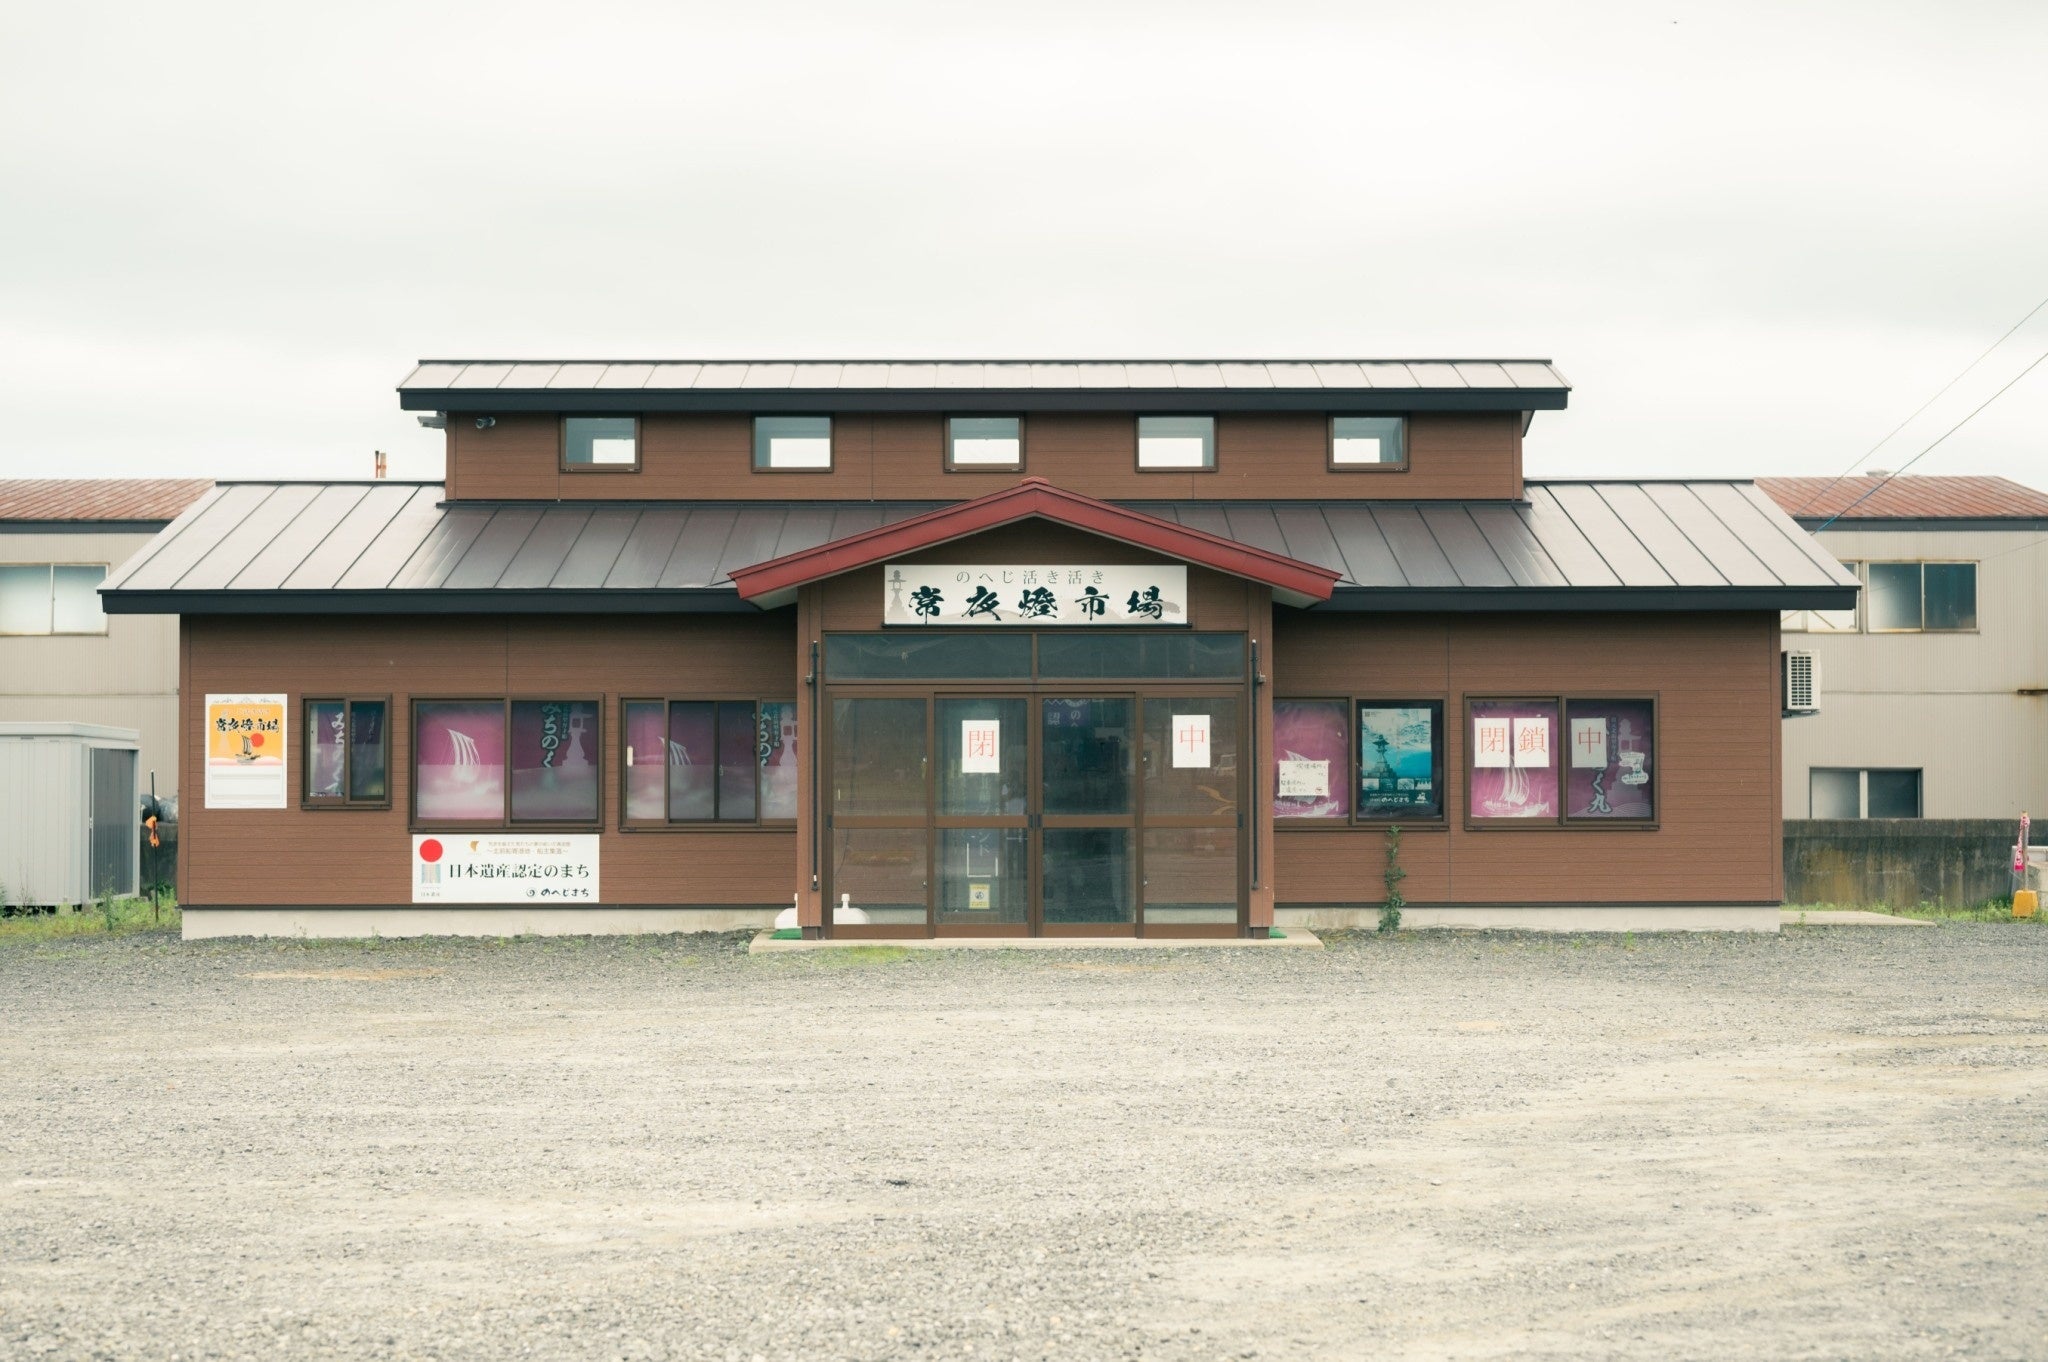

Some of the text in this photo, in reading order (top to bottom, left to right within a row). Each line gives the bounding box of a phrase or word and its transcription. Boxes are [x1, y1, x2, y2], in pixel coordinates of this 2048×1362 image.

[956, 569, 1105, 585] のへじ活き活き
[909, 585, 1164, 624] 常夜燈市場
[967, 730, 995, 759] 閉
[1179, 724, 1205, 754] 中
[1480, 726, 1506, 755] 閉
[1518, 725, 1546, 755] 鎖
[1577, 725, 1603, 756] 中
[449, 863, 590, 879] 日本遺産認定のまち
